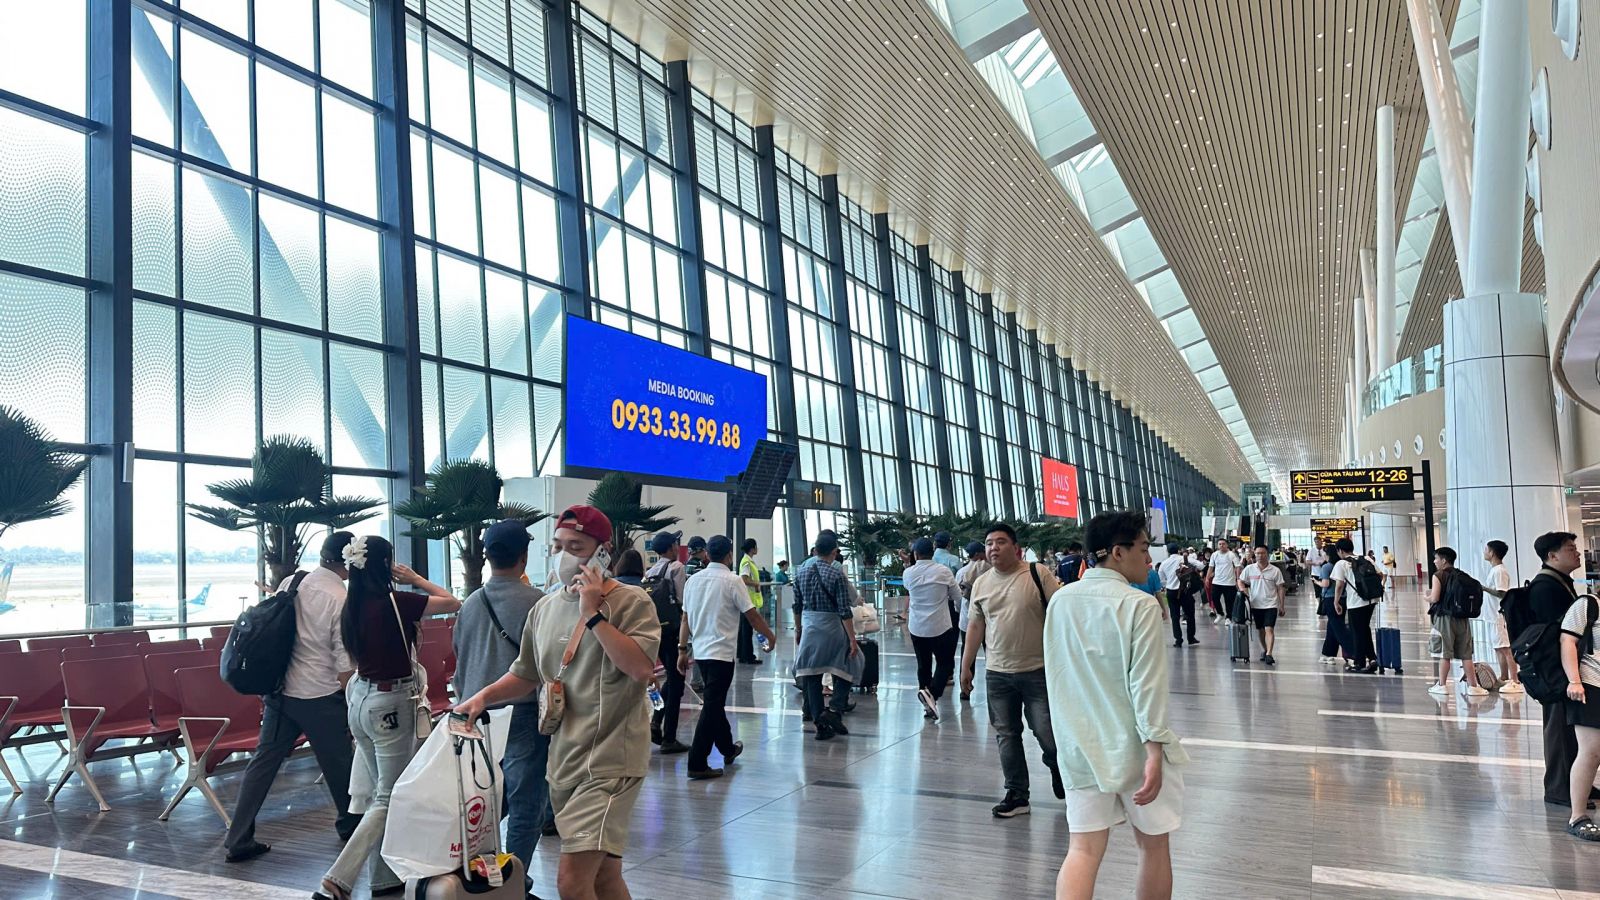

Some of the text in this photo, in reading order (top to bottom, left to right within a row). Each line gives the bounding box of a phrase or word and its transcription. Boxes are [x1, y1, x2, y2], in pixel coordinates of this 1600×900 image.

[648, 378, 715, 406] MEDIA BOOKING
[611, 398, 741, 450] 0933.33.99.88
[1368, 469, 1408, 483] 12-26
[814, 487, 823, 504] 11
[1369, 487, 1385, 499] 11
